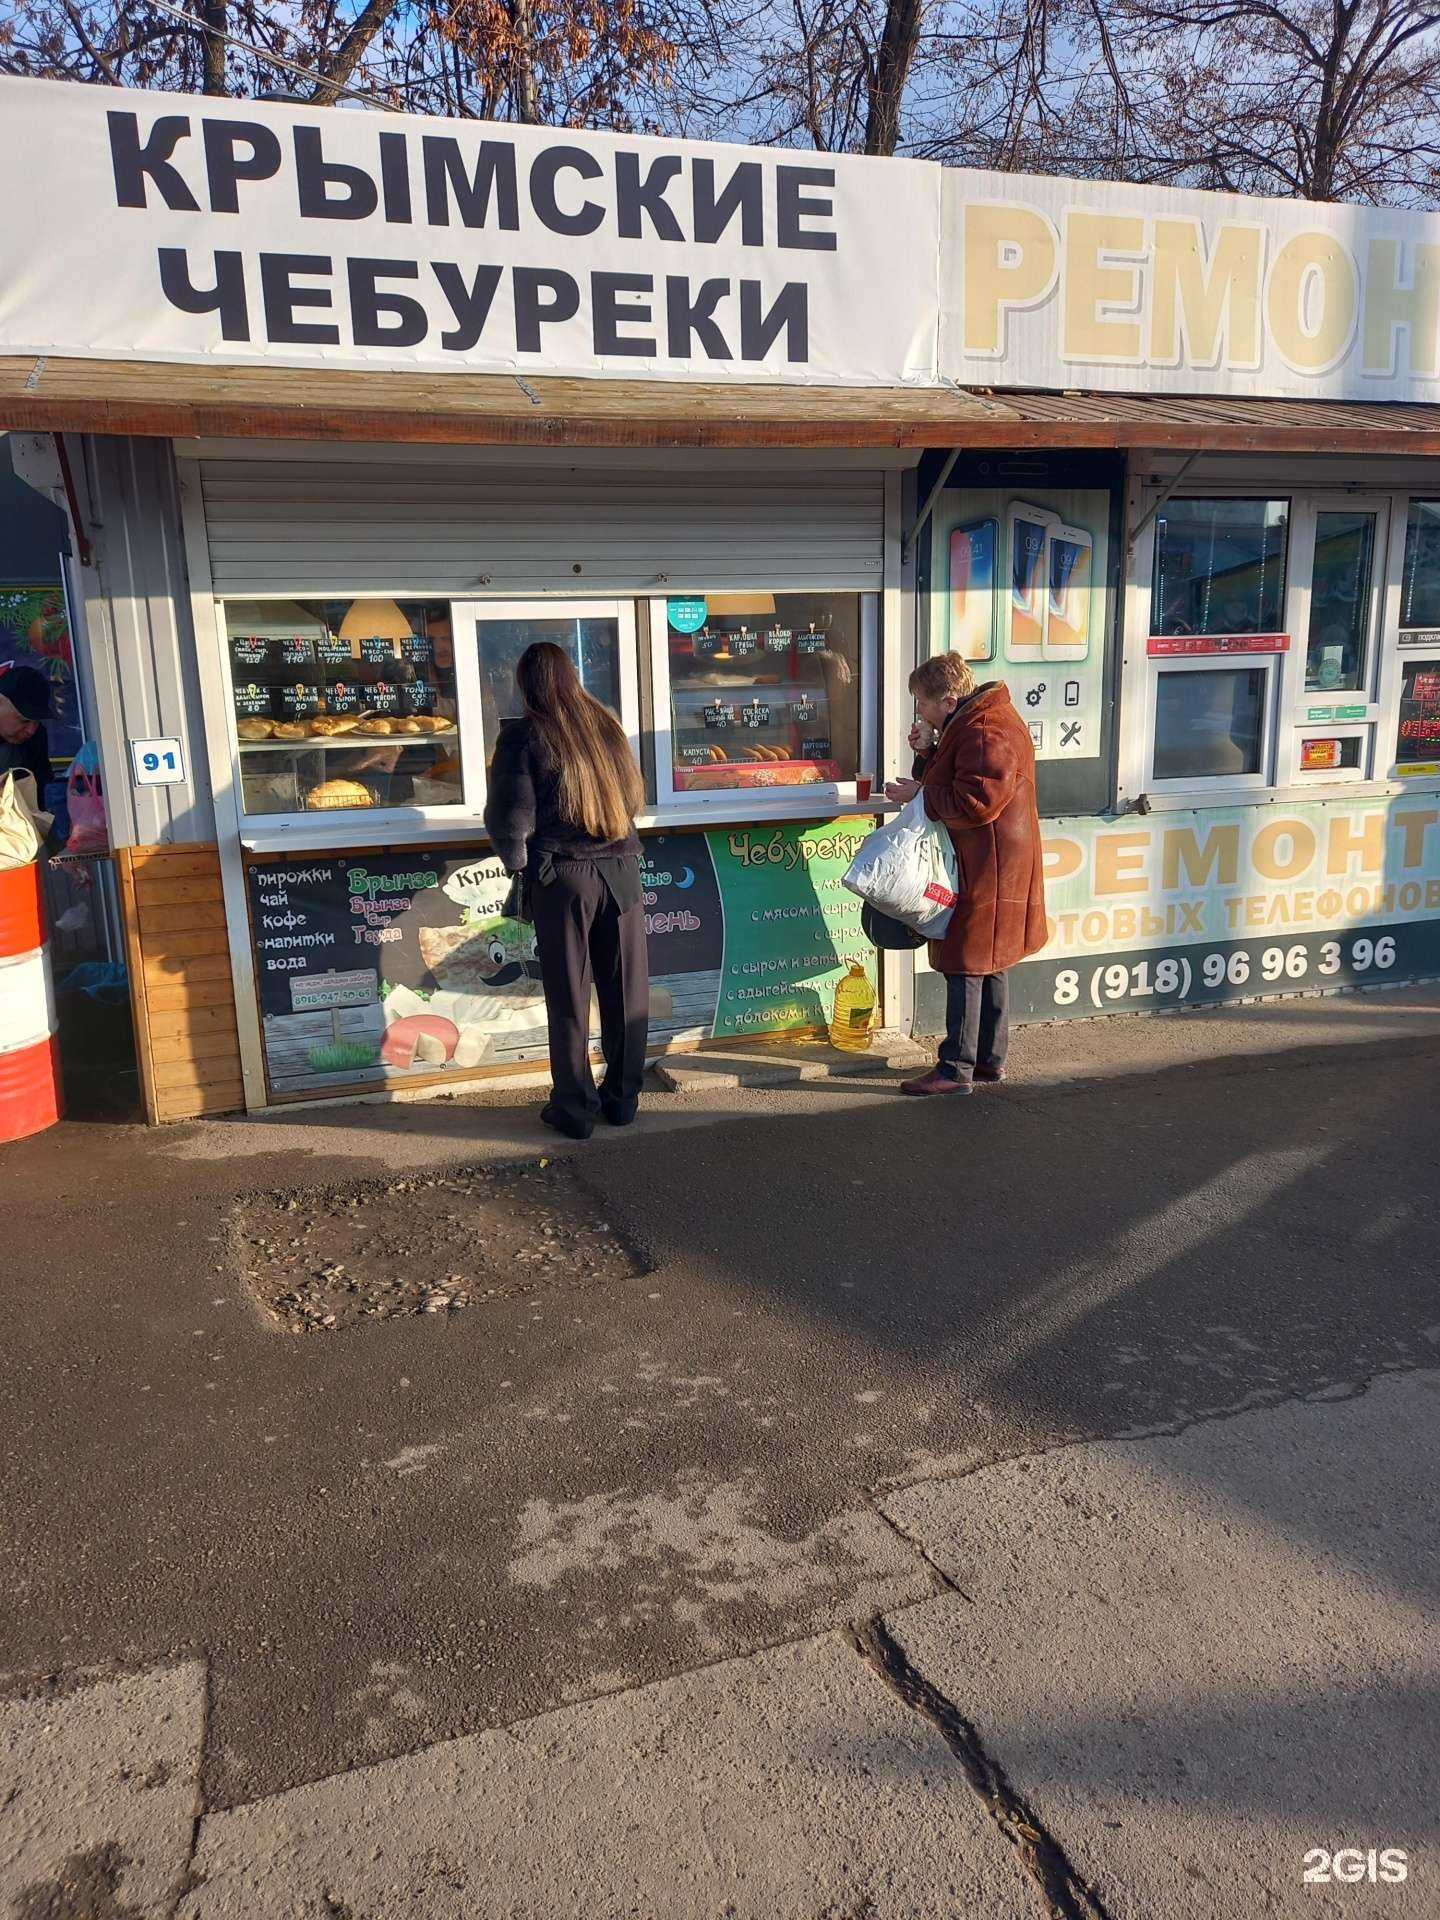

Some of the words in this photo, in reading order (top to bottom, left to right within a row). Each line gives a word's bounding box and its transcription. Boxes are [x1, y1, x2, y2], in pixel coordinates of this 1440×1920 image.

[106, 110, 838, 252] КРЫМСКИЕ
[157, 247, 809, 364] ЧЕБУРЕКИ
[296, 703, 307, 711] 80
[799, 712, 808, 720] 40
[143, 752, 175, 771] 91
[683, 748, 711, 756] КАПУСТА
[258, 867, 332, 887] пирожки
[347, 868, 438, 899] Брынза
[260, 889, 289, 906] чай
[349, 896, 412, 916] Брынза
[1225, 879, 1440, 929] ТЕЛЕФОНОВ
[262, 910, 307, 931] кофе
[752, 911, 759, 921] с
[763, 904, 810, 920] мясом
[264, 931, 336, 950] напитки
[814, 930, 820, 940] с
[267, 955, 307, 971] вода
[732, 963, 738, 975] с
[742, 960, 787, 976] сыром
[1053, 969, 1080, 1006] 8
[1090, 957, 1192, 1008] (918)
[1203, 952, 1250, 987] 96
[1261, 944, 1308, 981] 96
[1318, 941, 1341, 975] 3
[1351, 936, 1397, 972] 96
[726, 992, 734, 1001] с
[724, 1016, 732, 1026] с
[735, 1007, 798, 1026] яблоком
